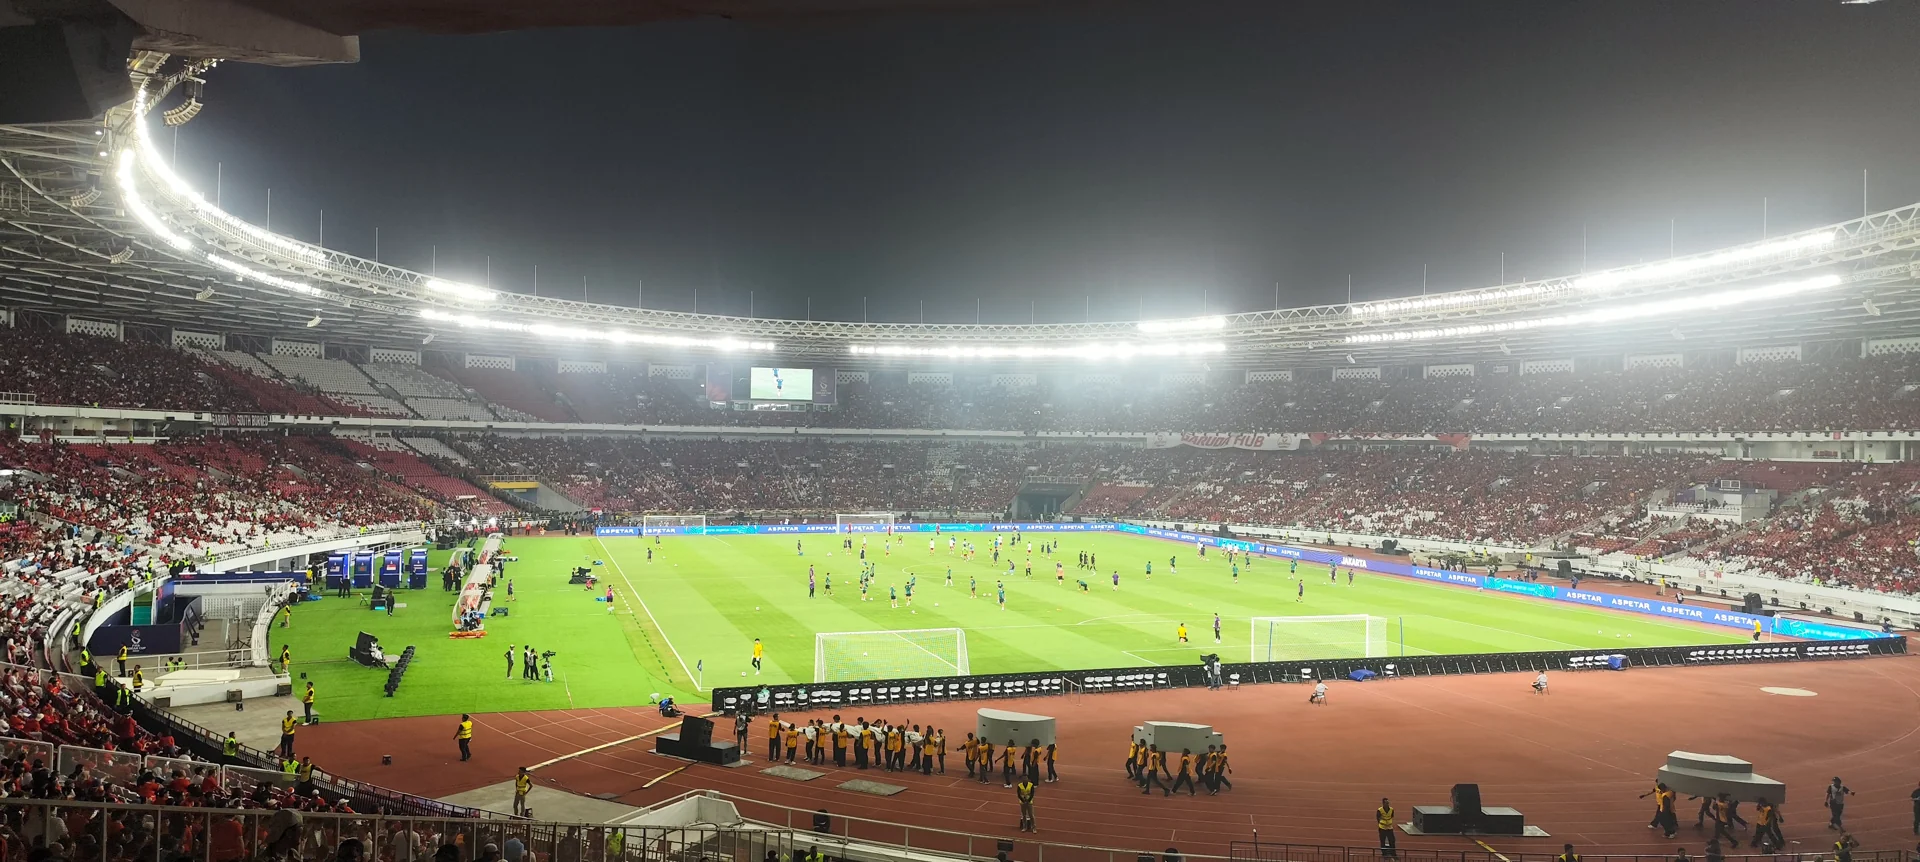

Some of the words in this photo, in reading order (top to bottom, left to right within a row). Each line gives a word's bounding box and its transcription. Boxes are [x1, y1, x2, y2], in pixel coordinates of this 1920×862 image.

[237, 414, 251, 427] SOUTH
[1180, 433, 1231, 448] GARUDA
[1234, 434, 1264, 448] HUB
[1281, 549, 1300, 557] ASPETAR
[1341, 556, 1367, 568] JAKARTA
[1415, 569, 1442, 578] ASPETAR
[1448, 574, 1476, 584] ASPETAR
[1566, 591, 1602, 604] ASPETAR
[1612, 598, 1650, 611] ASPETAR
[1660, 606, 1703, 618] ASPETAR
